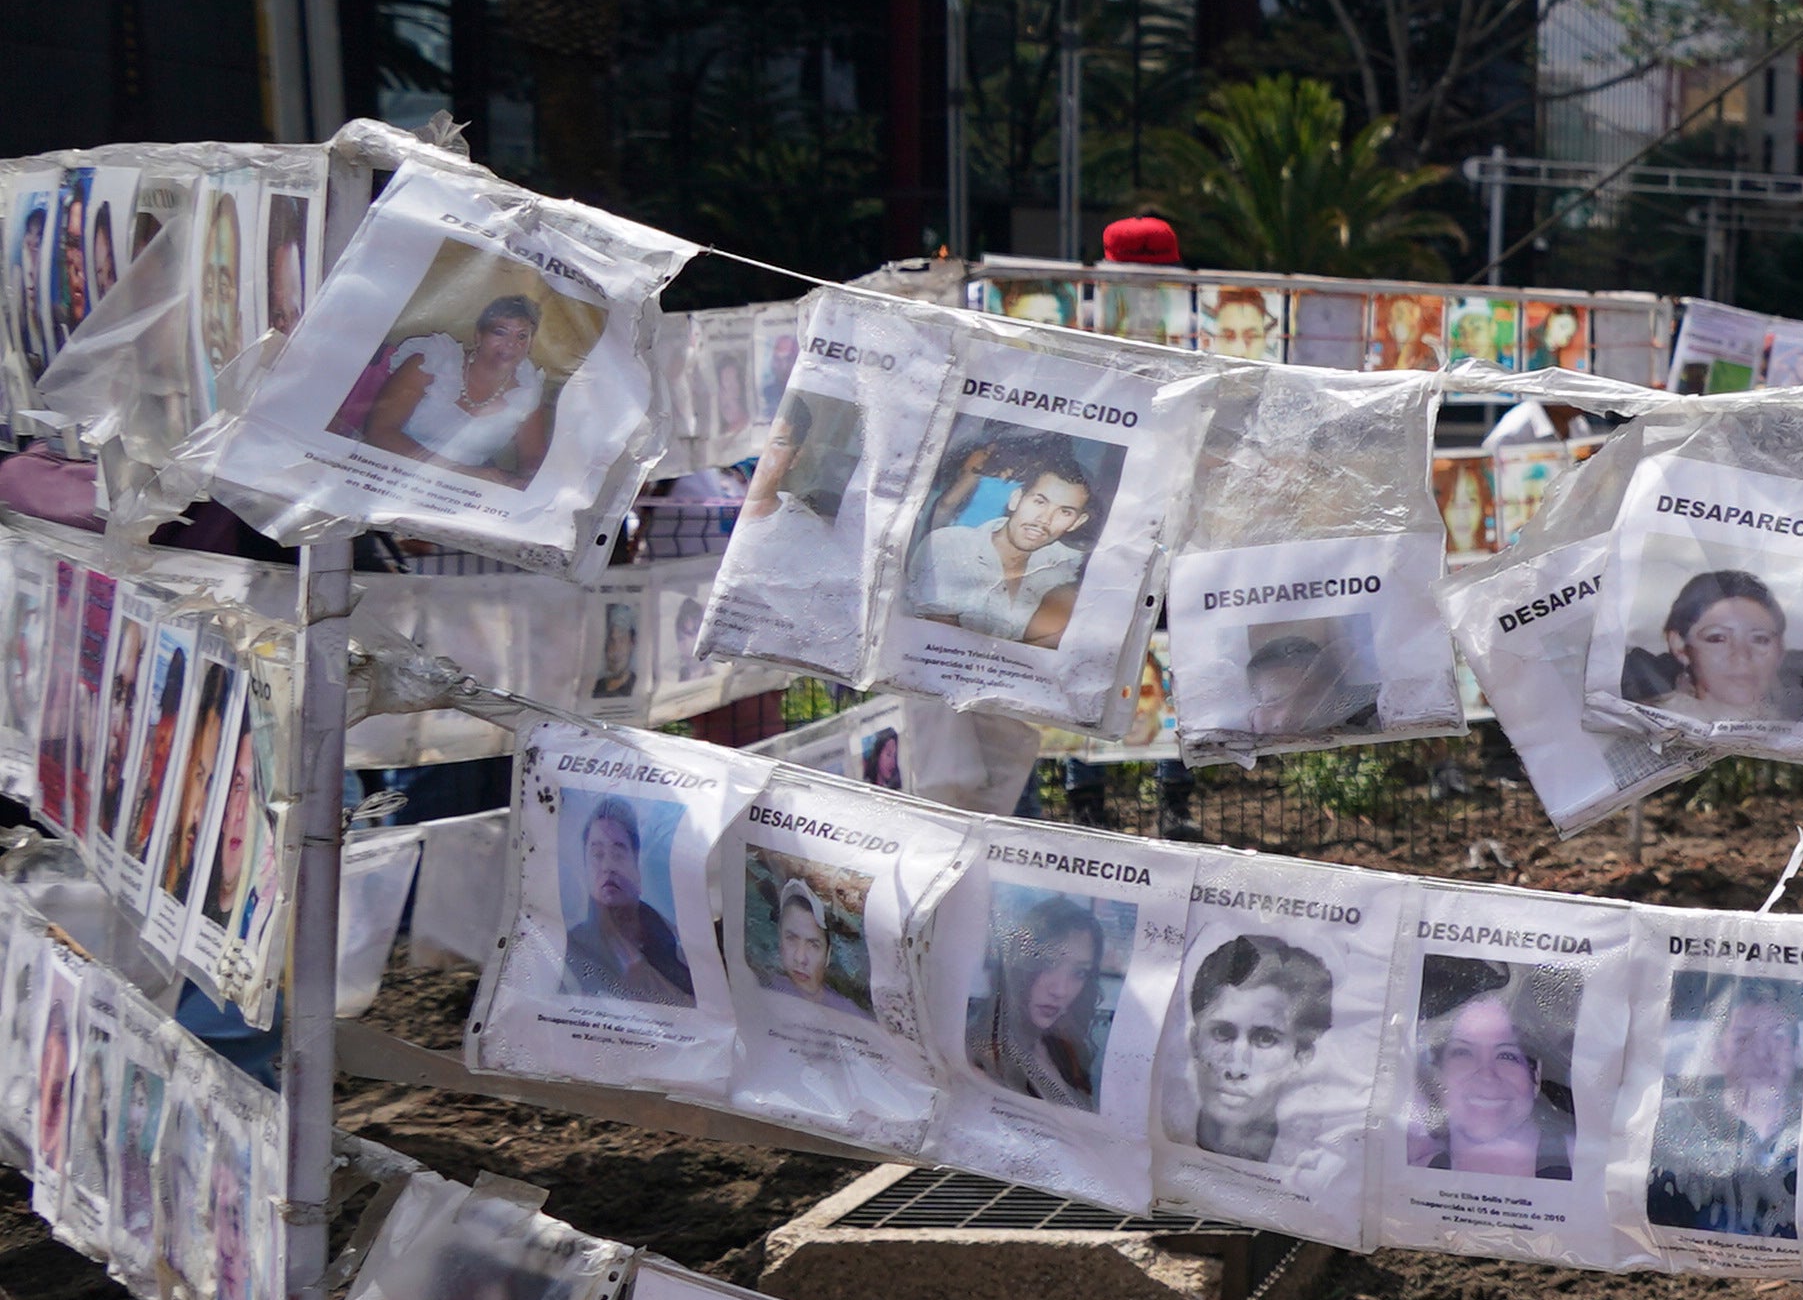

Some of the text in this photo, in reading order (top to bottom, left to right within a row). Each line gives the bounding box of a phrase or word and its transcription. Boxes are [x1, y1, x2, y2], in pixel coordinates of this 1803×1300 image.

[962, 378, 1138, 429] DESAPARECIDO
[1203, 574, 1381, 610] DESAPARECIDO
[557, 753, 717, 792] DESAPARECIDO
[748, 805, 899, 855] DESAPARECIDO
[986, 843, 1152, 886] DESAPARECIDA
[1190, 884, 1361, 926] DESAPARECIDO
[1417, 920, 1593, 956] DESAPARECIDA
